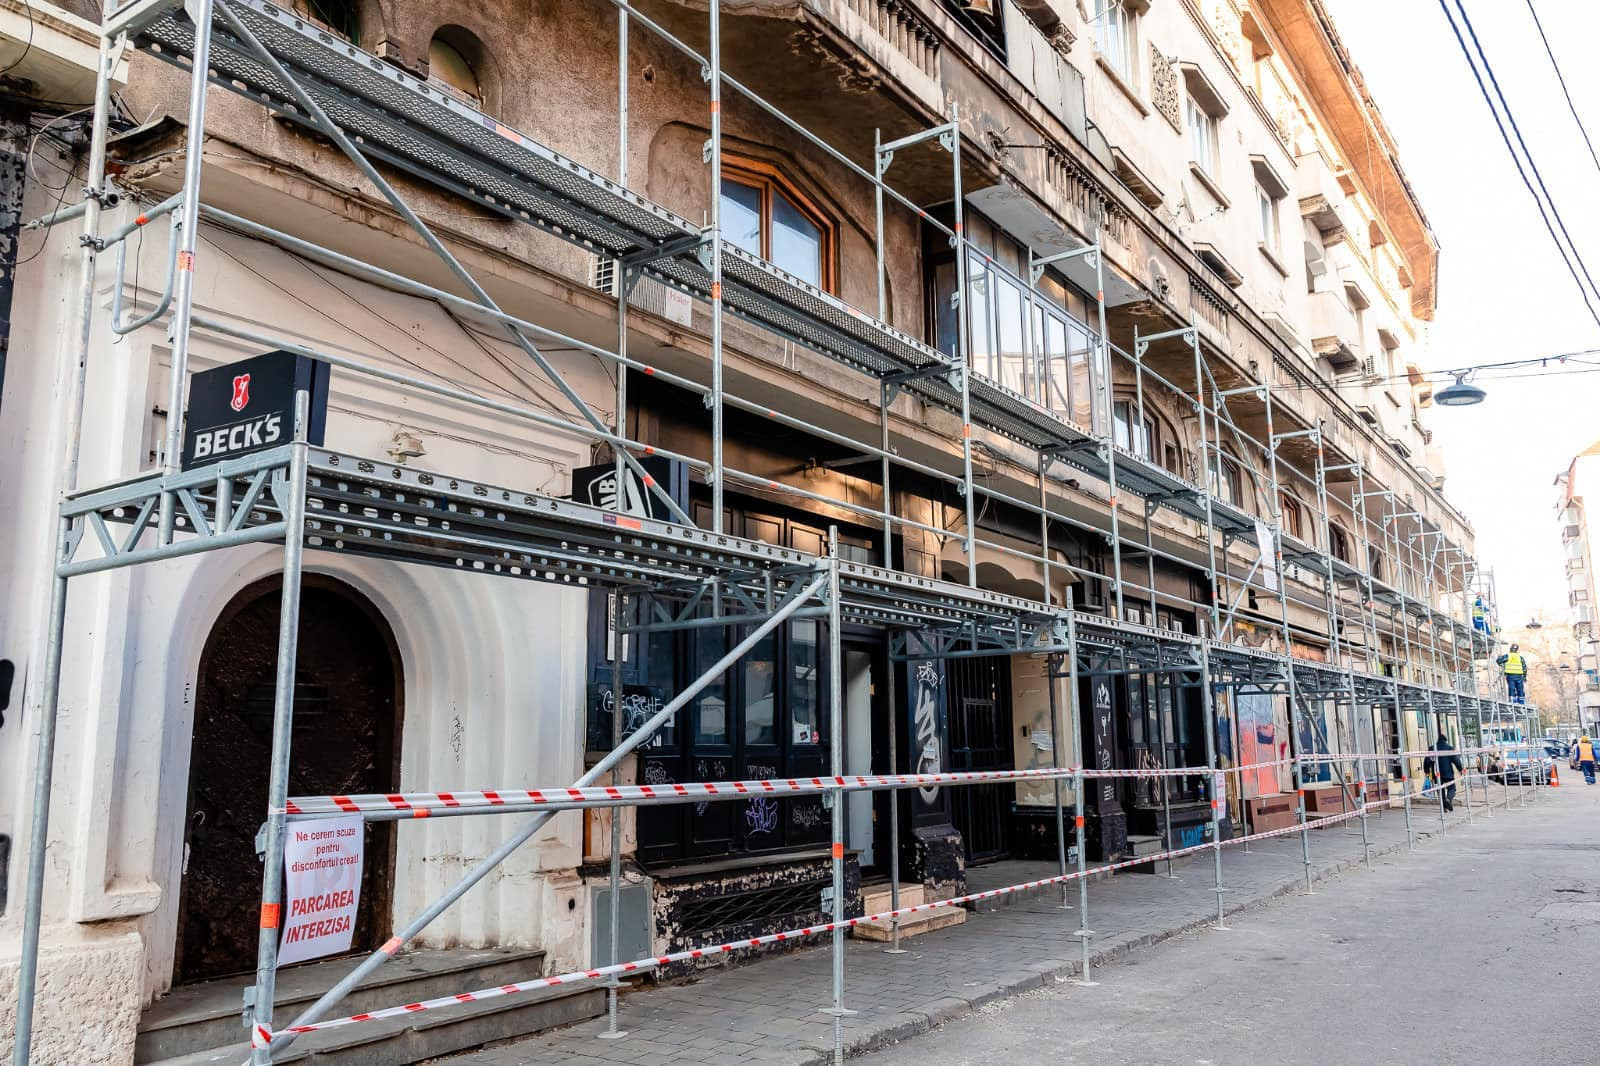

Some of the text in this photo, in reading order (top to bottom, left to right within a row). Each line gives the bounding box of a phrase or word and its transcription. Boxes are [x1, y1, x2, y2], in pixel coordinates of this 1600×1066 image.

[193, 414, 281, 460] BECK'S
[296, 827, 356, 842] Ne cerem scuze
[316, 843, 340, 857] pentru
[291, 857, 339, 873] disconfortul
[291, 889, 354, 918] PARCAREA
[286, 915, 350, 944] INTERZISA
